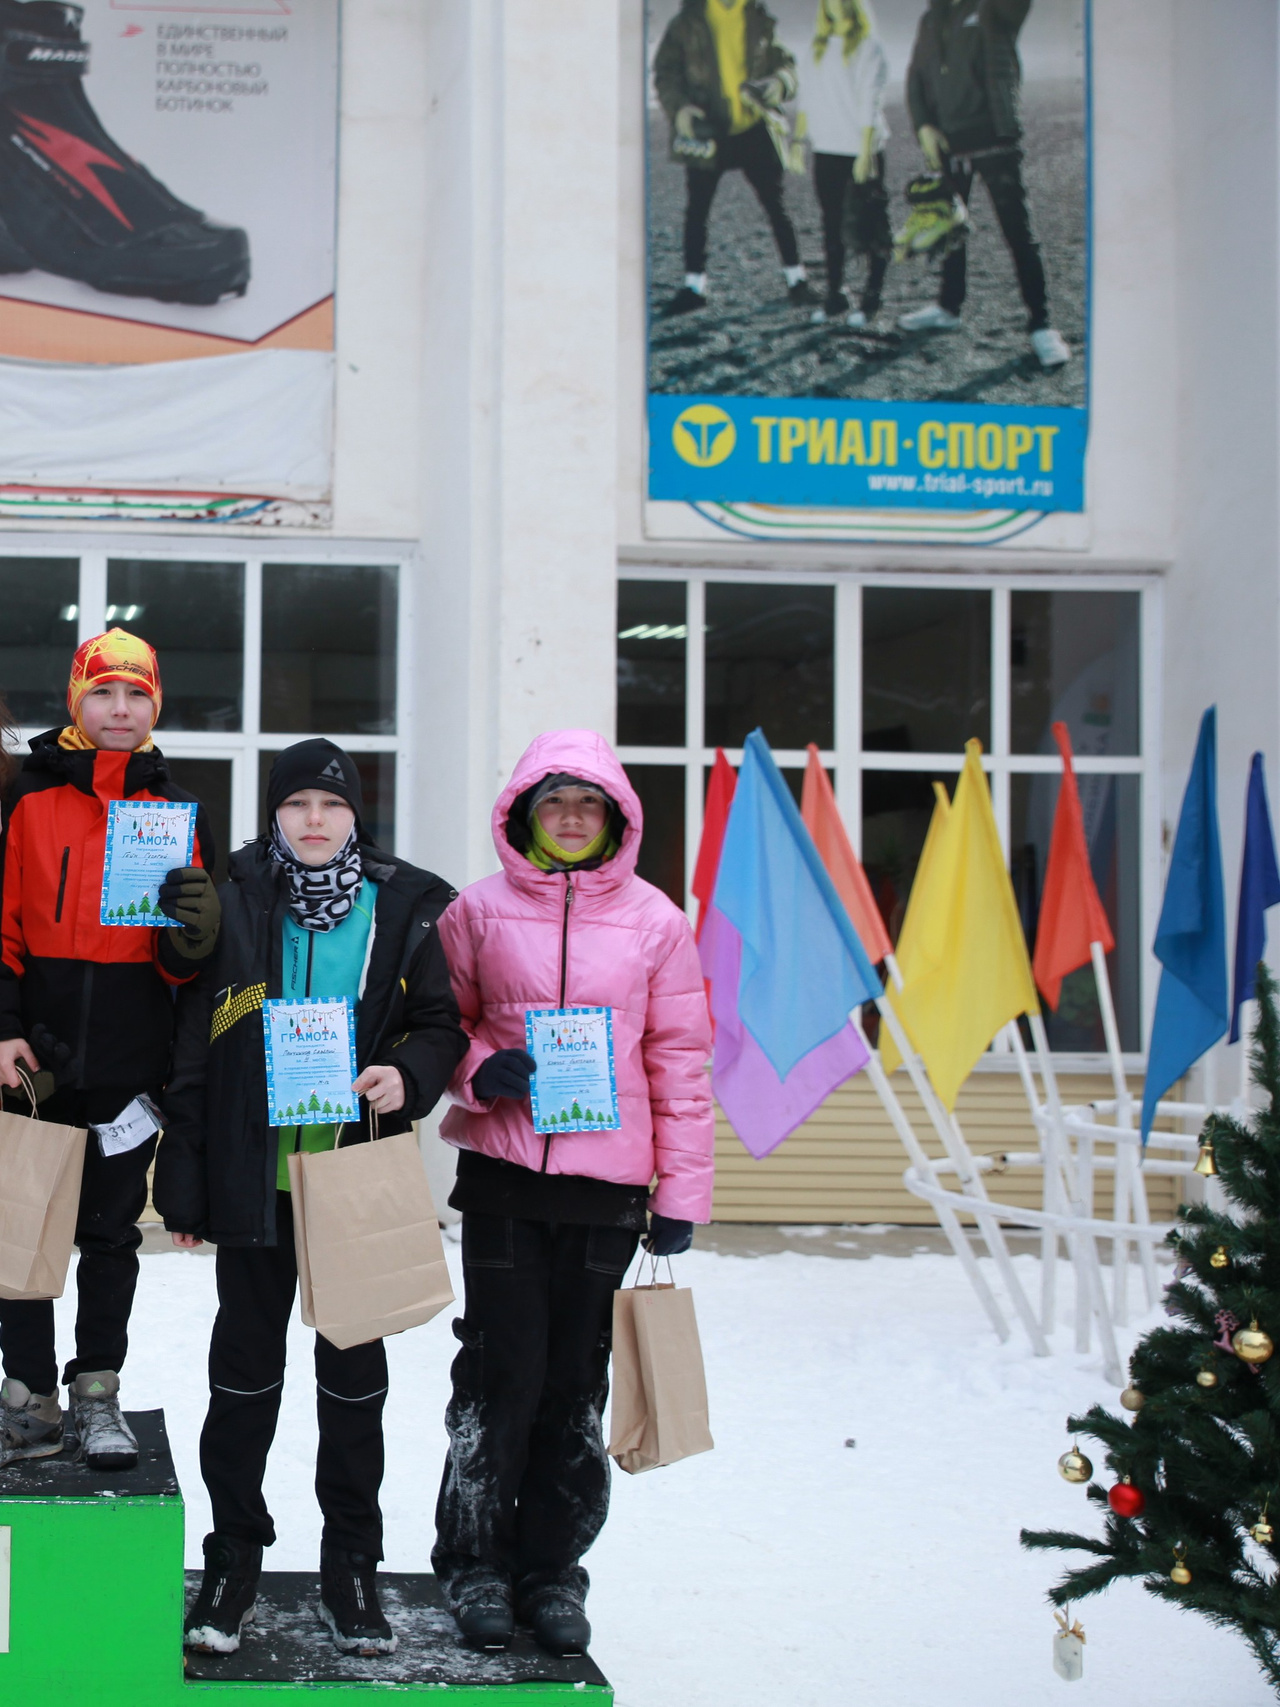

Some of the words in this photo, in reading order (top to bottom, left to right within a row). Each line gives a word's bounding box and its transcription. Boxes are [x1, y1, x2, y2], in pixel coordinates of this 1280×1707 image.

[157, 24, 288, 41] ЕДИНСТВЕННЫЙ
[157, 43, 167, 57] В
[170, 43, 213, 58] МИРЕ
[157, 61, 261, 78] ПОЛНОСТЬЮ
[156, 80, 269, 96] КАРБОНОВЫЙ
[155, 97, 234, 113] БОТИНОК
[867, 473, 1054, 498] www.trial-sport.ru
[96, 664, 148, 676] FISCHER
[122, 834, 178, 846] ГРАМОТА
[291, 945, 300, 991] FISCHER
[280, 1030, 338, 1043] ГРАМОТА
[542, 1041, 598, 1053] ГРАМОТА
